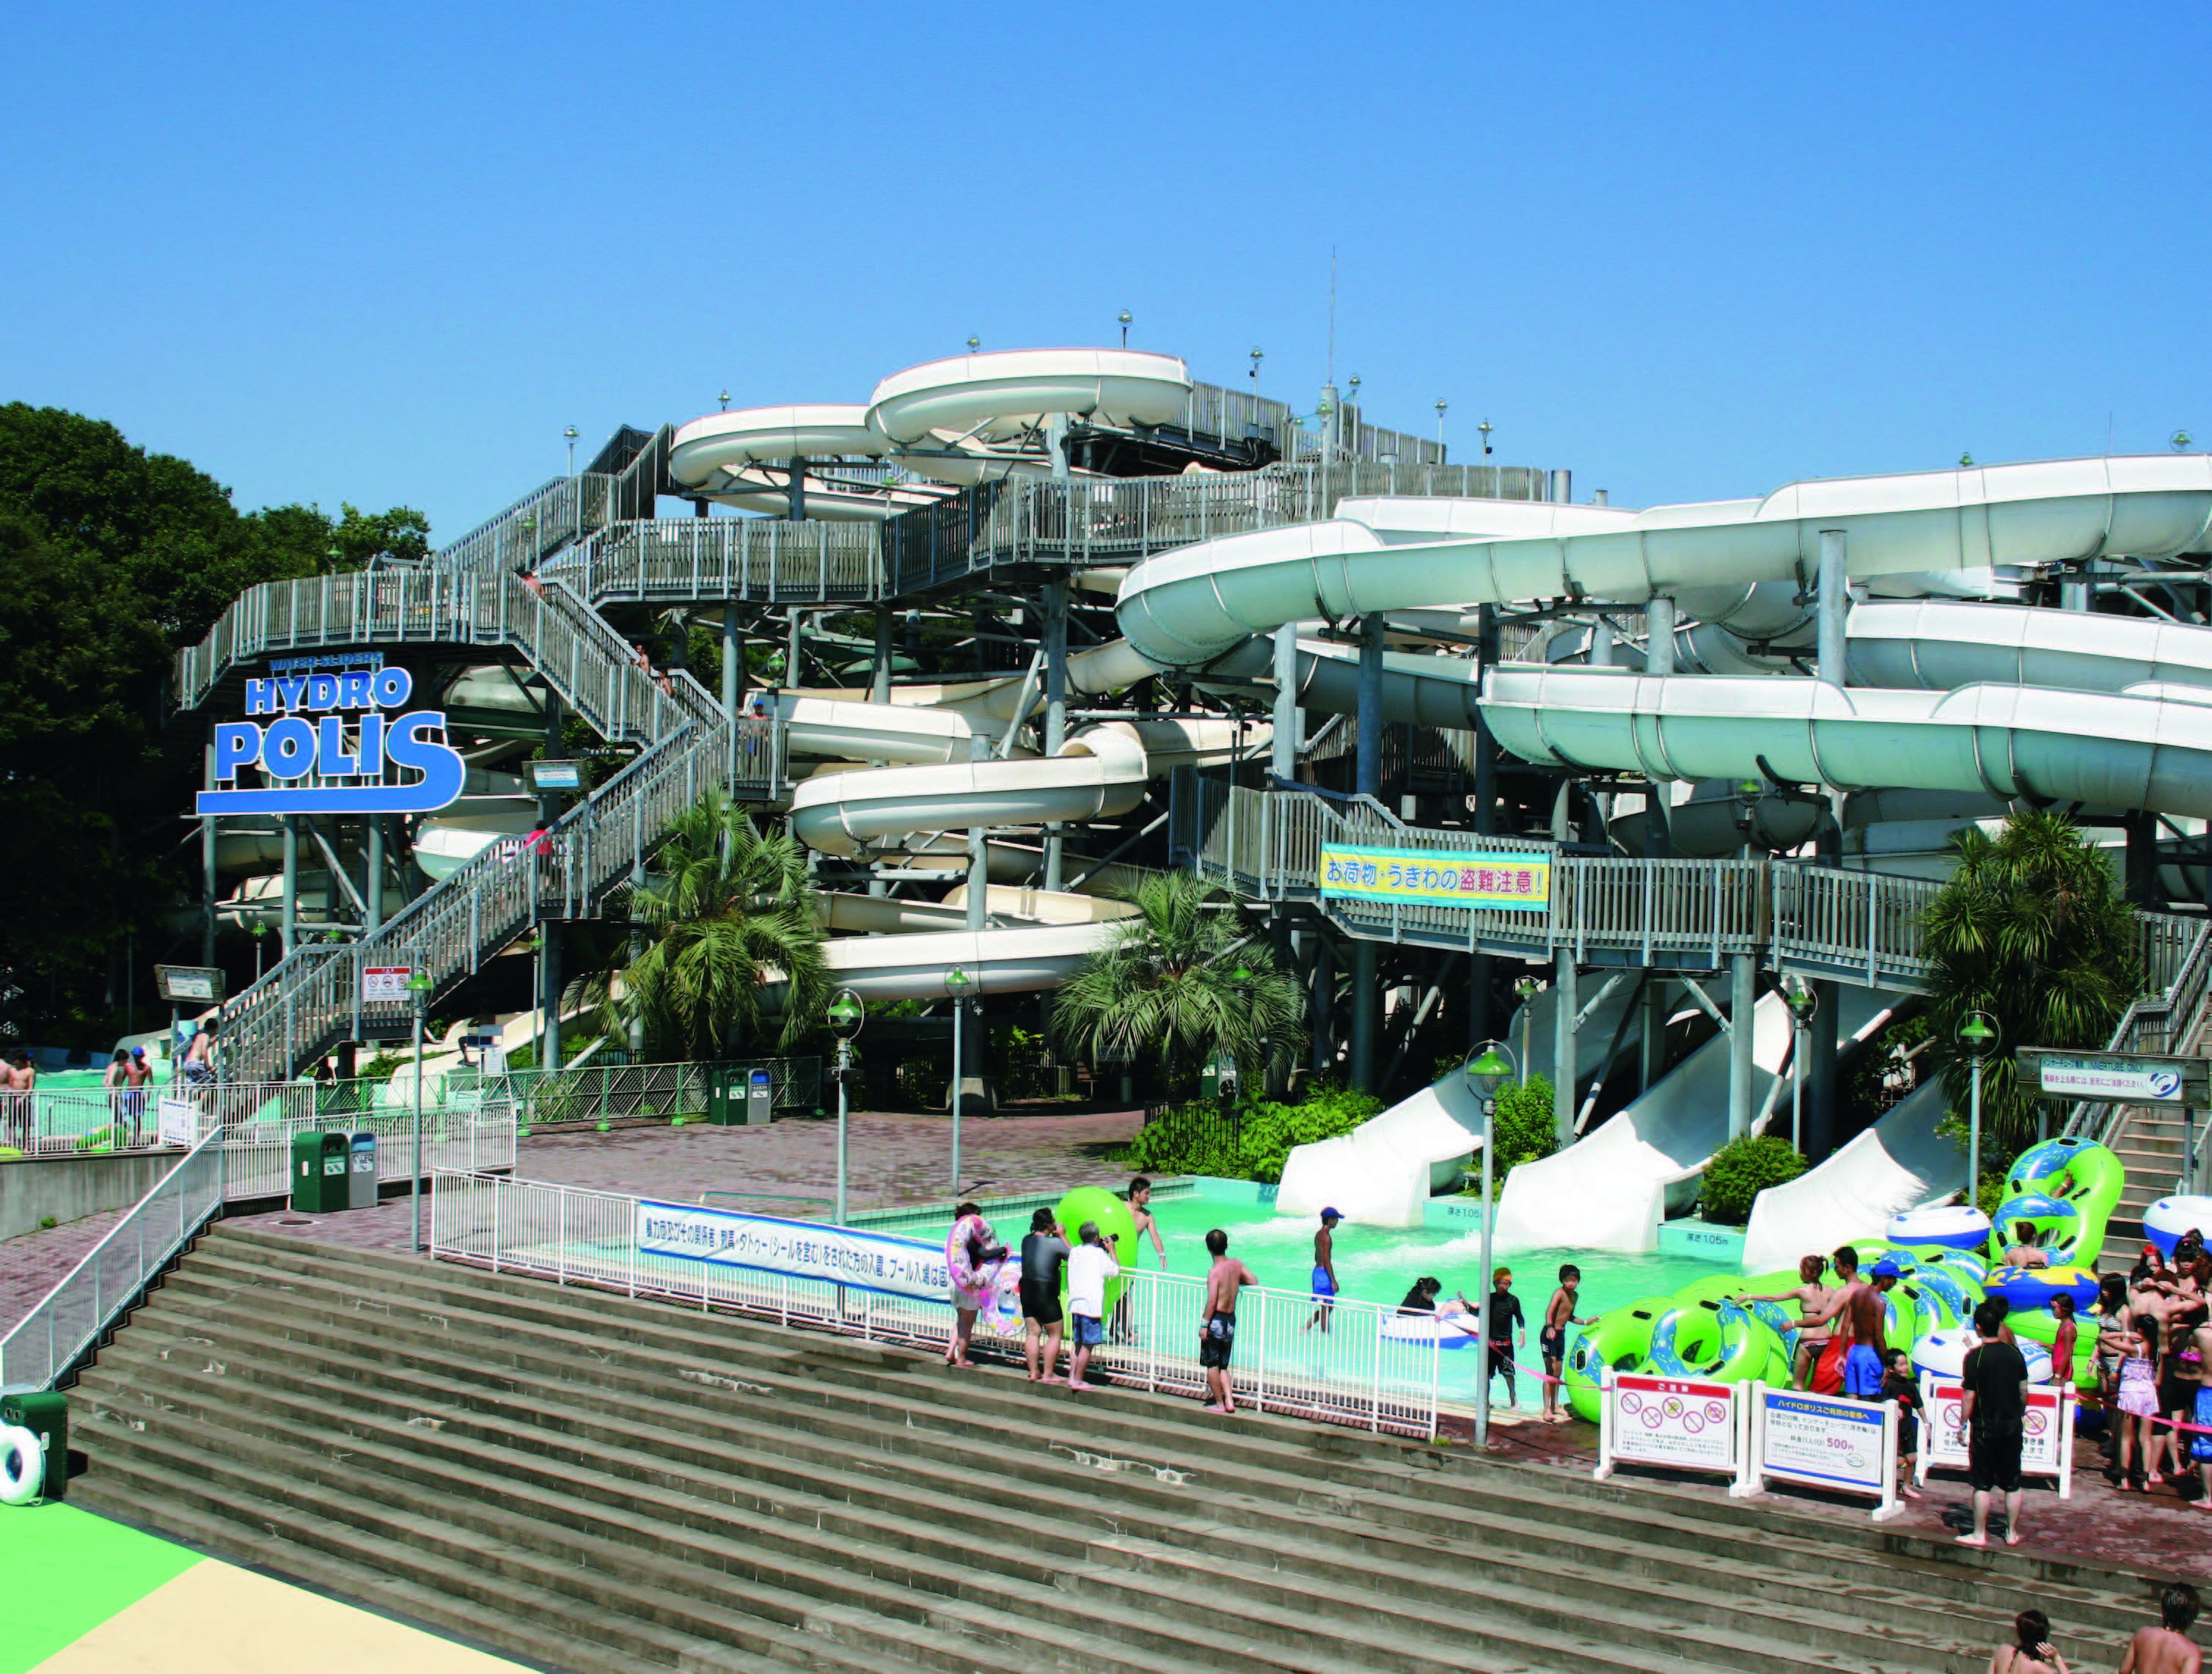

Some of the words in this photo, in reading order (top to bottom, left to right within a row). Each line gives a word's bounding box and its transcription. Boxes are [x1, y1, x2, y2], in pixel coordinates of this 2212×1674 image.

[269, 656, 318, 671] WATER
[245, 666, 413, 715] HYDRO
[196, 710, 467, 816] POLIS
[1326, 860, 1542, 895] お荷物・うきわの盗難注意！
[1828, 1438, 1854, 1451] 500円
